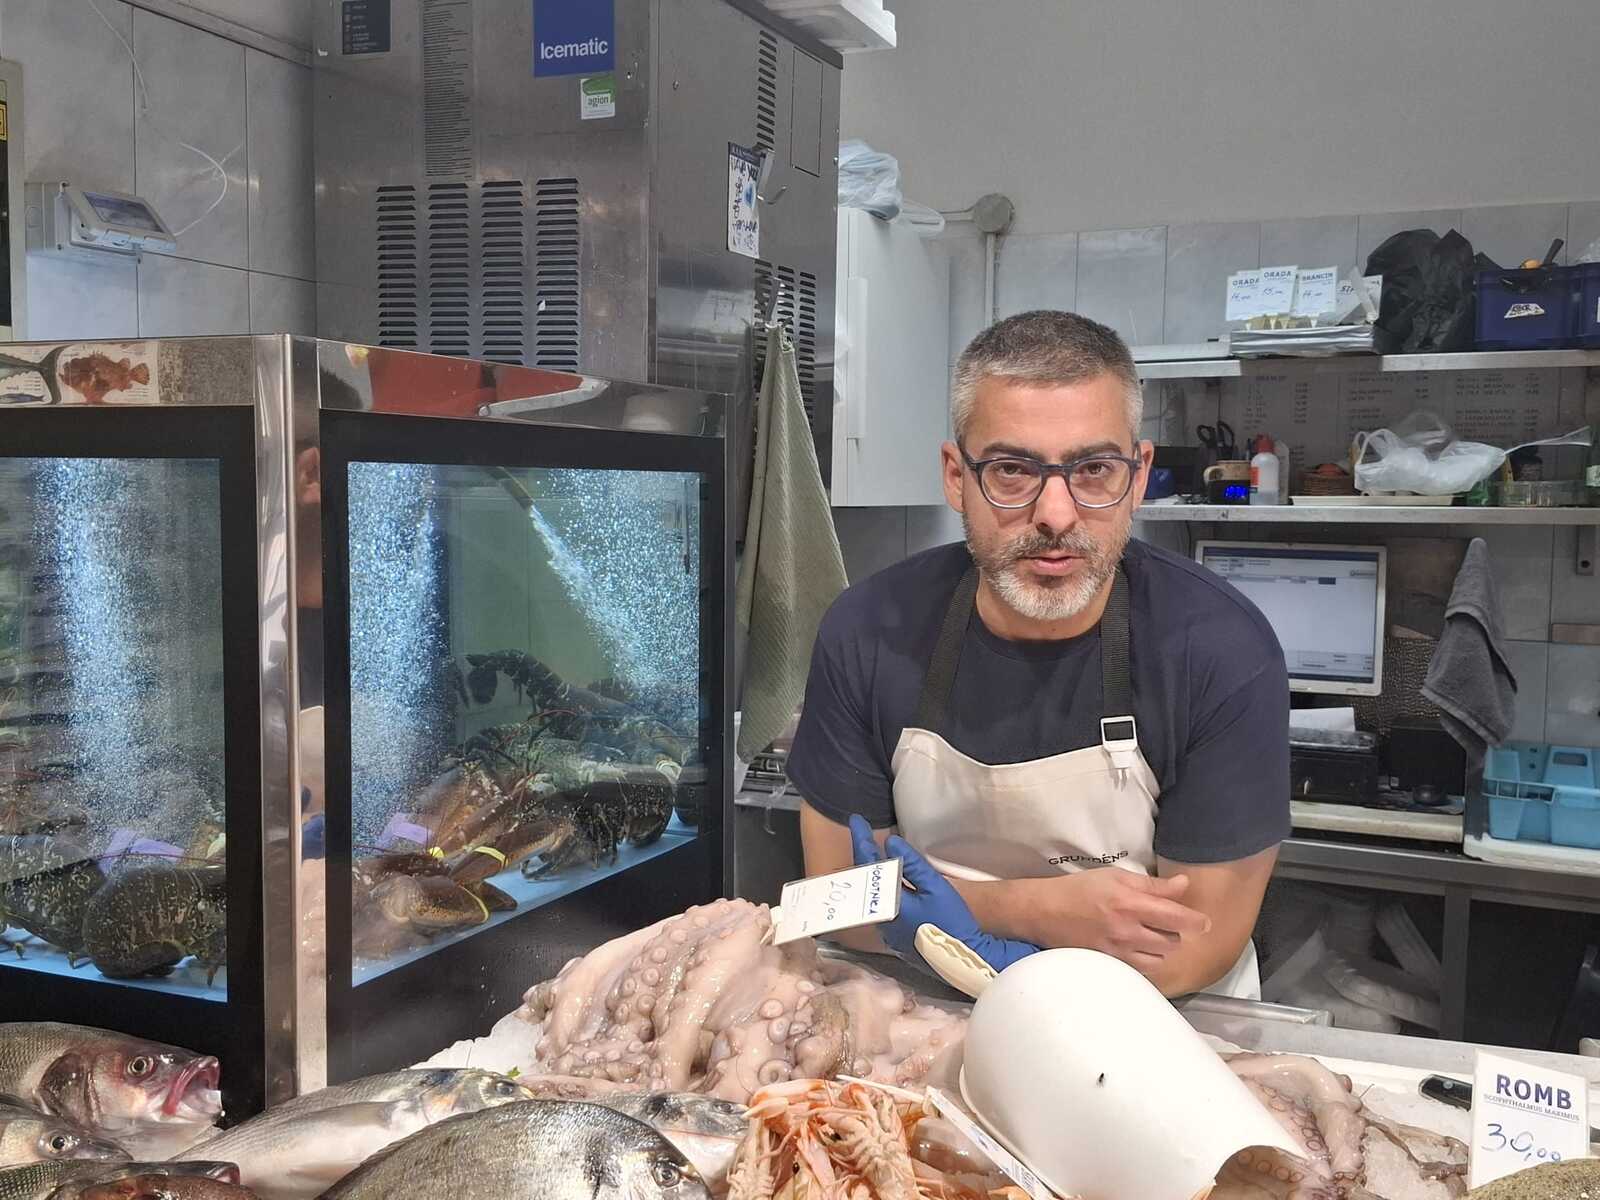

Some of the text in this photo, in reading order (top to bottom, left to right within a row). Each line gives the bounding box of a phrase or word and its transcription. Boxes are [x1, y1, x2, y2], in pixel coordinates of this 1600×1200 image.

[540, 37, 608, 60] Icematic
[1263, 270, 1292, 278] ORADA
[823, 880, 852, 921] 20,00
[1496, 1073, 1572, 1110] ROMB
[1480, 1123, 1562, 1162] 30,00
